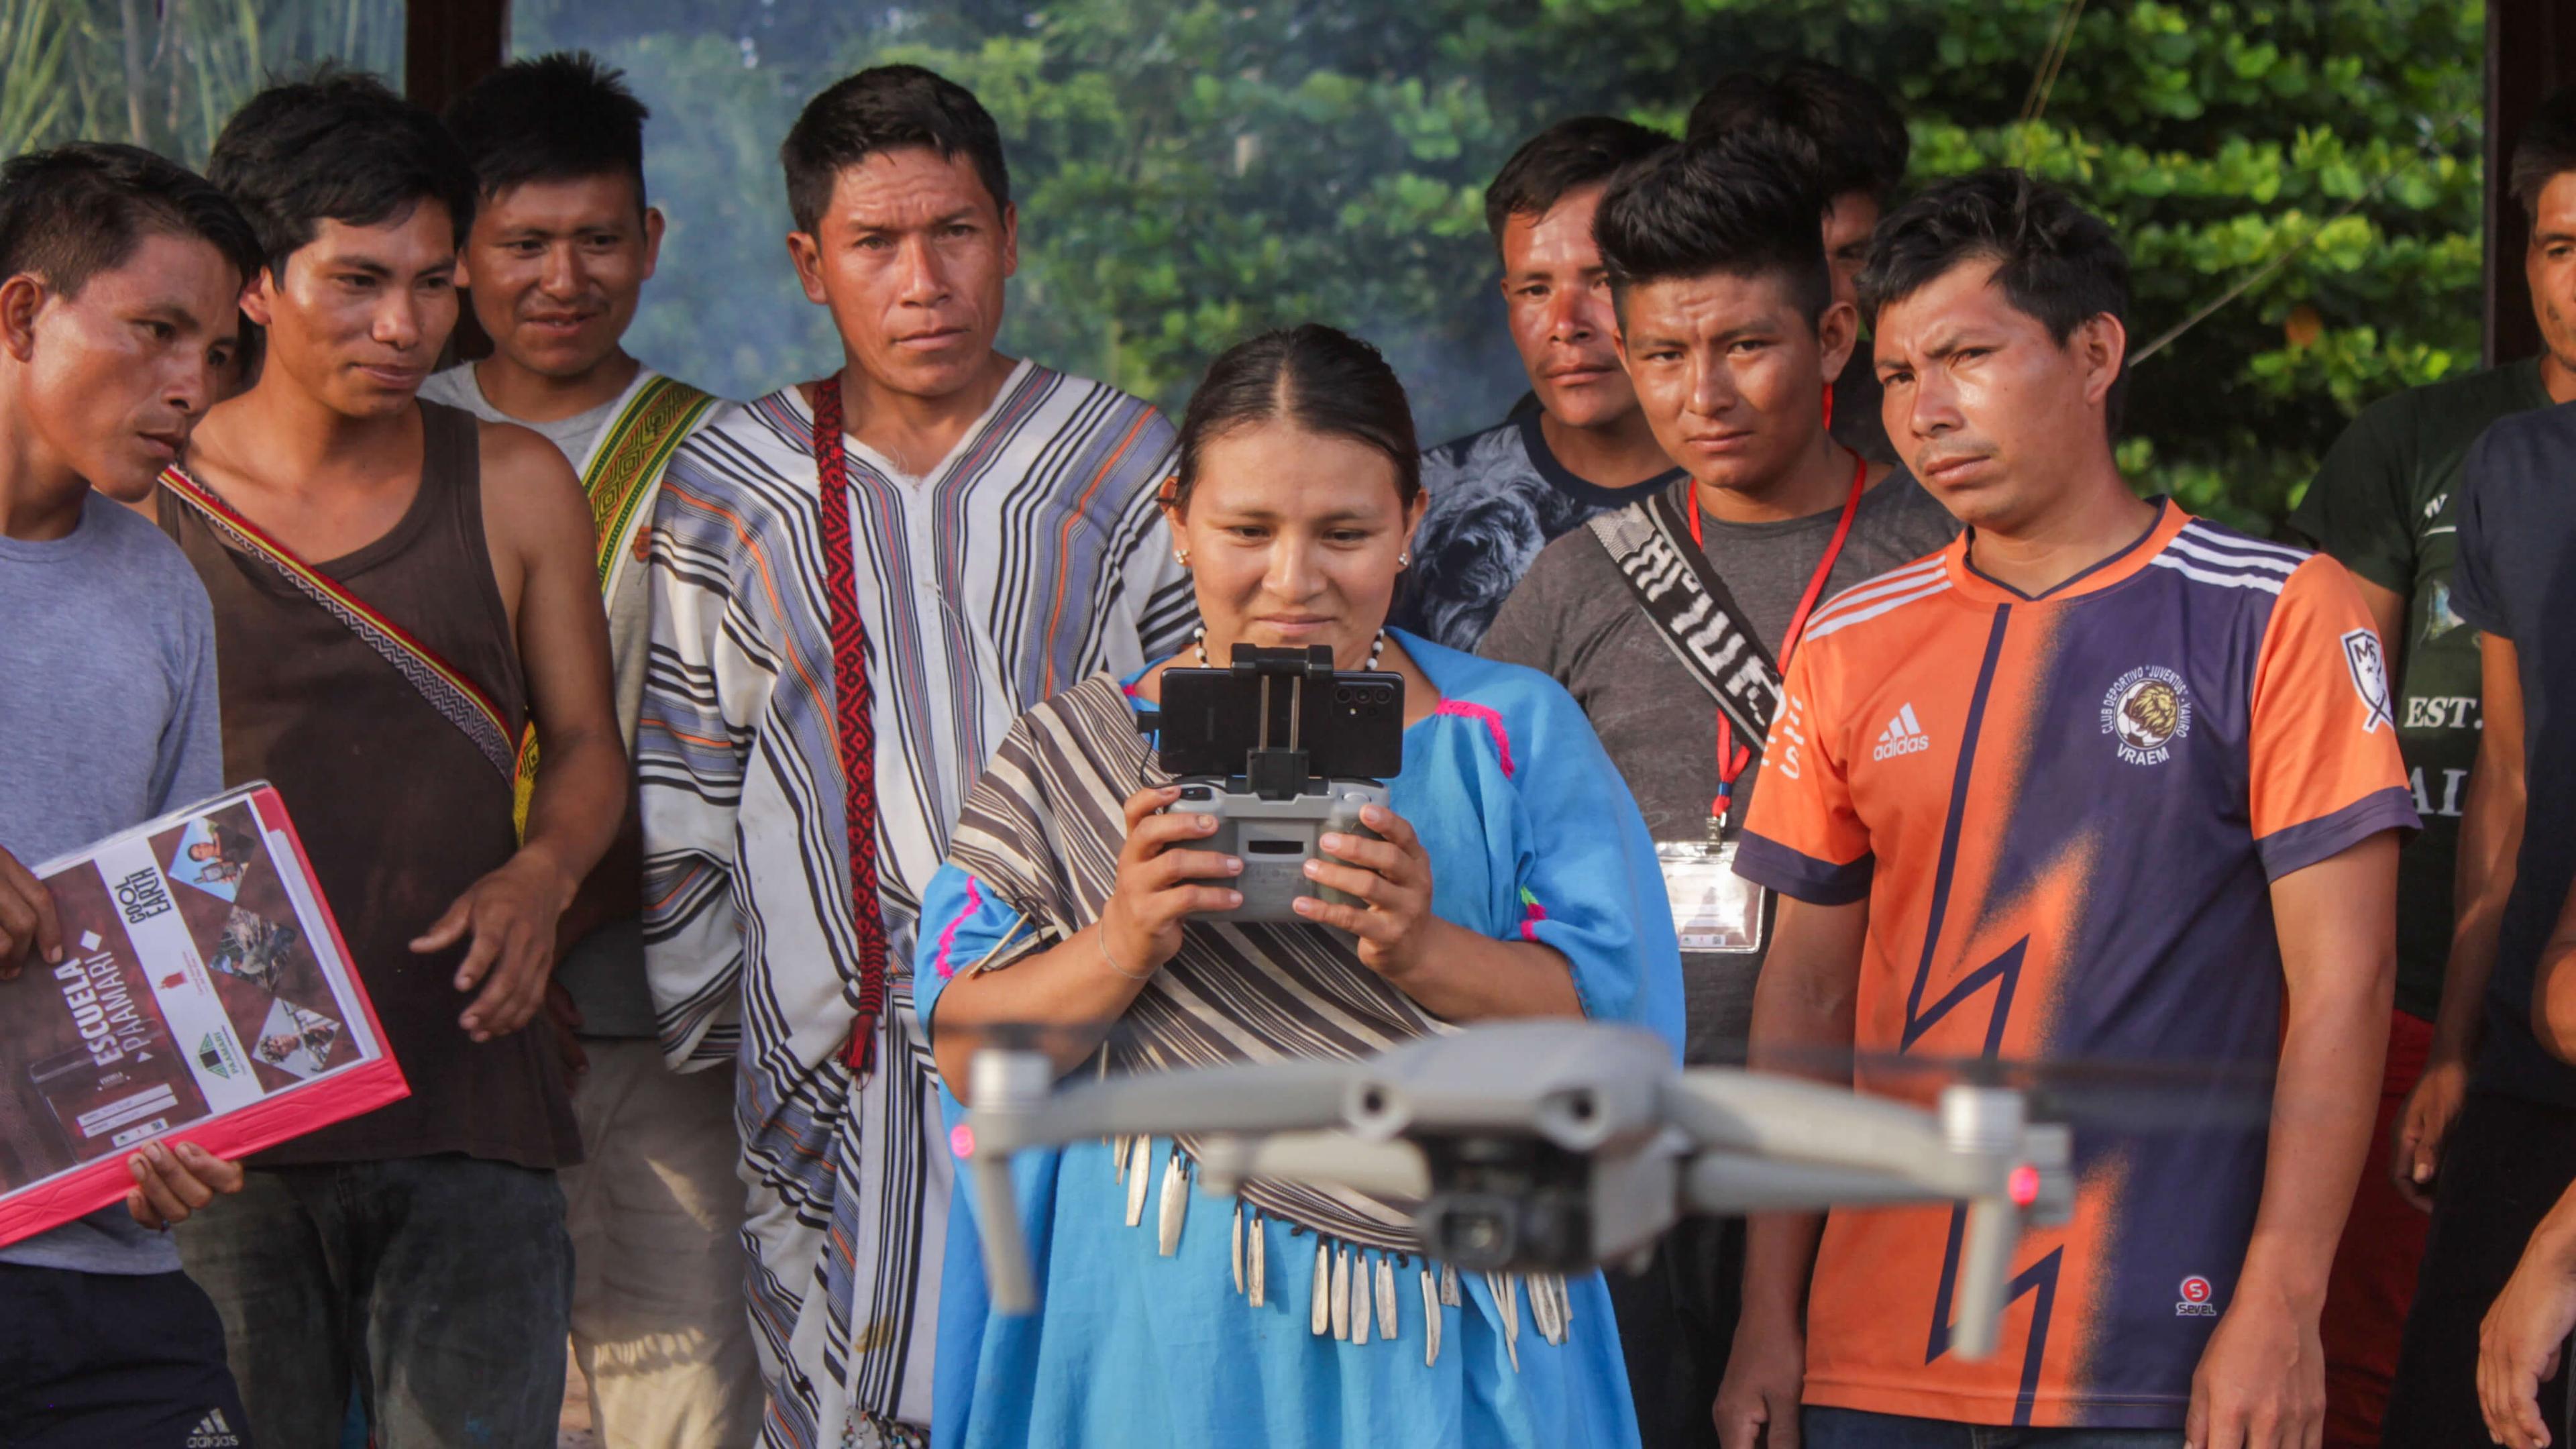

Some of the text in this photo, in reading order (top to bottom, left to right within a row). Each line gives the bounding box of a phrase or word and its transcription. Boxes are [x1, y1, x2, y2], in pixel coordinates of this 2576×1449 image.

[2103, 666, 2143, 707] DEPORTIVO
[2100, 708, 2114, 735] CLUB
[2404, 696, 2483, 729] EST.
[1873, 735, 1929, 762] adidas
[2117, 743, 2170, 765] VRAEM
[114, 875, 147, 924] COOL
[128, 866, 172, 918] EARTH
[54, 957, 124, 1067] ESCUELA
[85, 951, 152, 1052] PAAMARI
[186, 1434, 239, 1449] adidas
